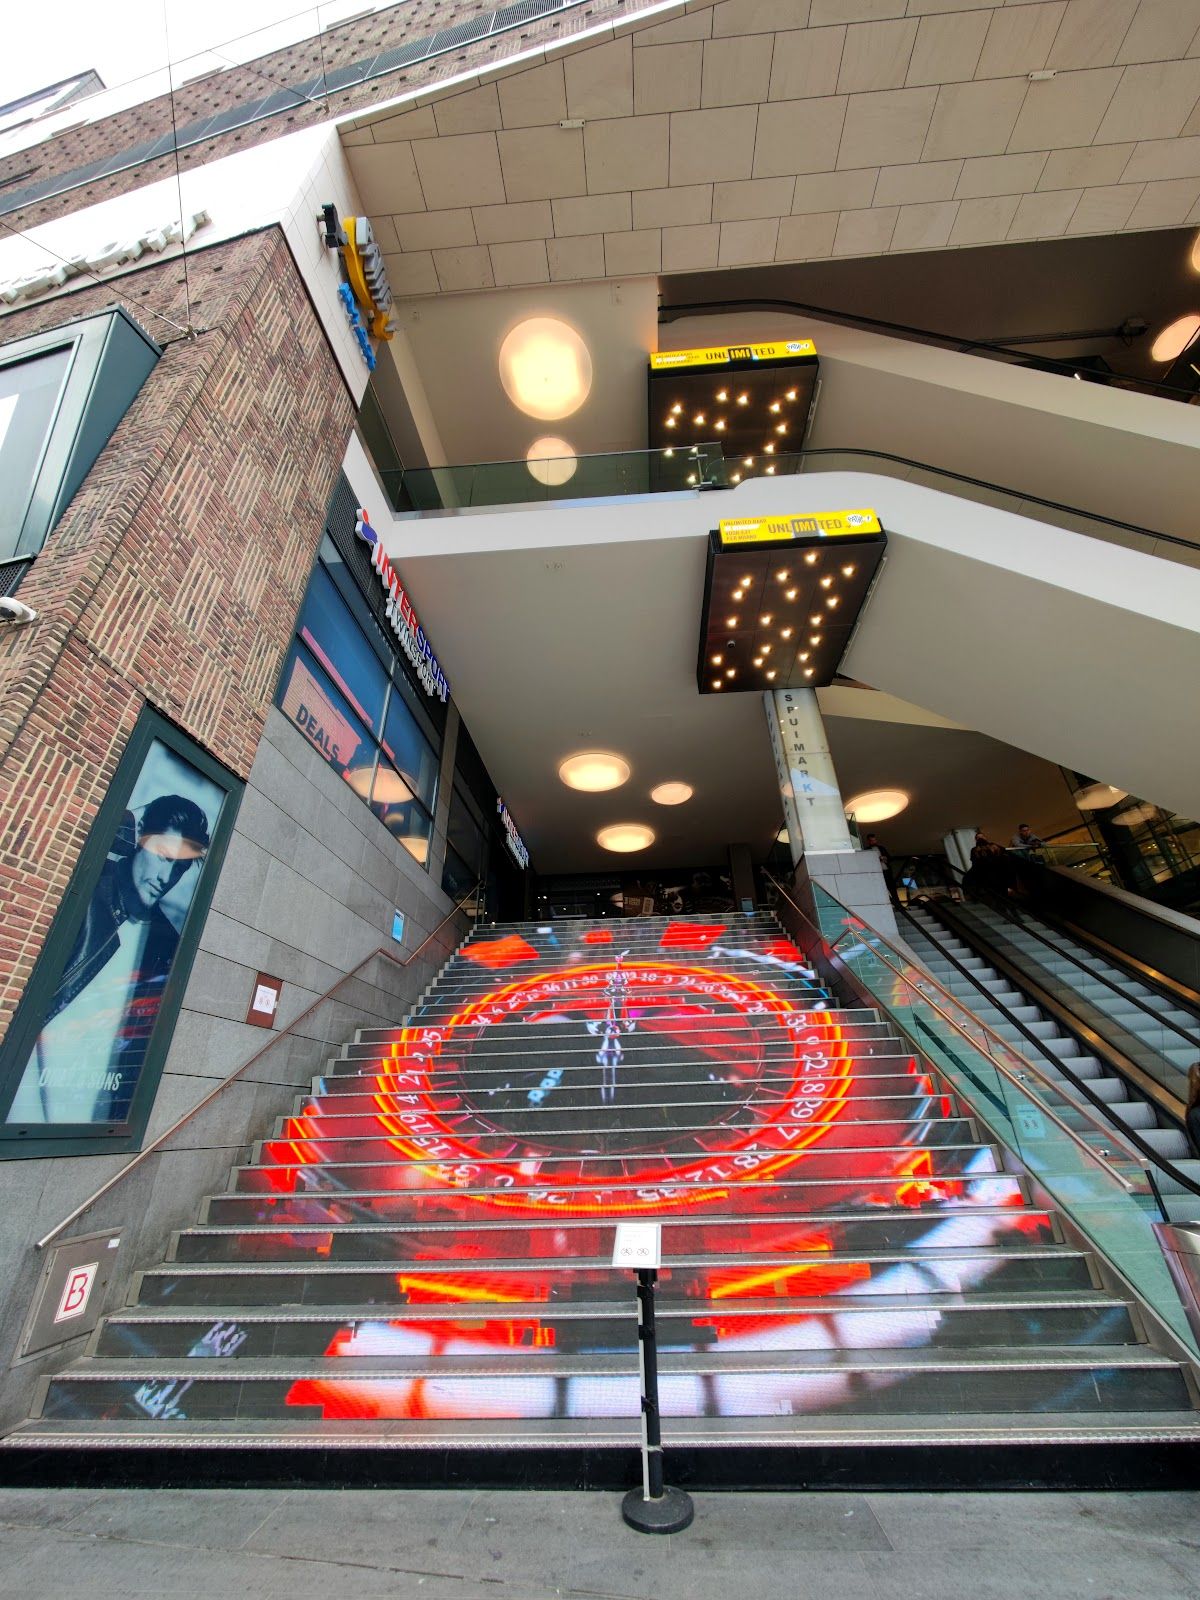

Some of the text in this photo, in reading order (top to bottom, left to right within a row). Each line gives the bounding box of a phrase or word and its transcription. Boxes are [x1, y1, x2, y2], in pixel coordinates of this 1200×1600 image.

[705, 347, 776, 360] UNLIMITED
[768, 518, 843, 535] UNLIMITED
[371, 542, 450, 703] INTERSPORT
[295, 703, 341, 762] DEALS
[784, 694, 816, 807] SPUIMARKT
[63, 1272, 88, 1312] B
